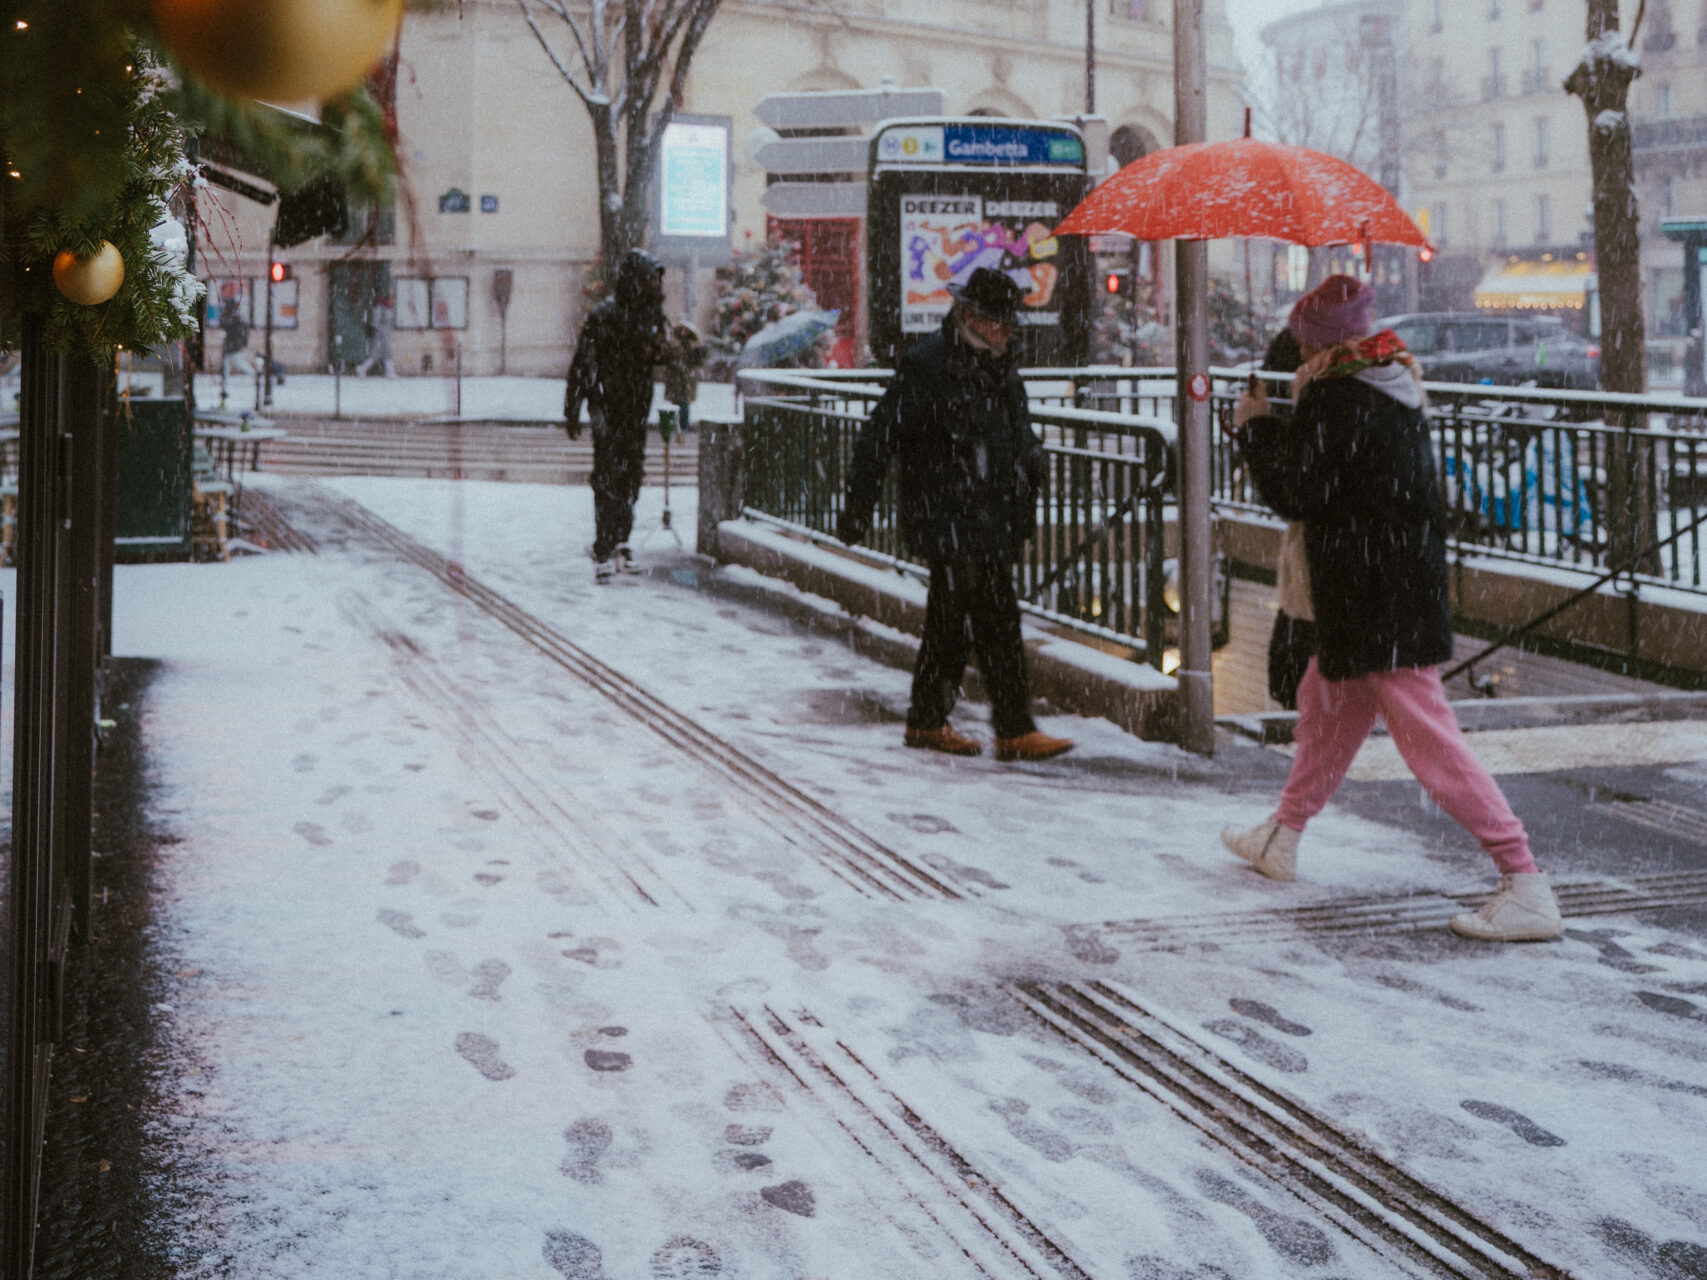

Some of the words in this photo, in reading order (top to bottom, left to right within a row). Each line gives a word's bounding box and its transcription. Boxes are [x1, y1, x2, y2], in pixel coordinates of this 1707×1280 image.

[948, 139, 1028, 158] Gambetta
[905, 201, 976, 214] DEEZER
[986, 201, 1058, 217] DEEZER
